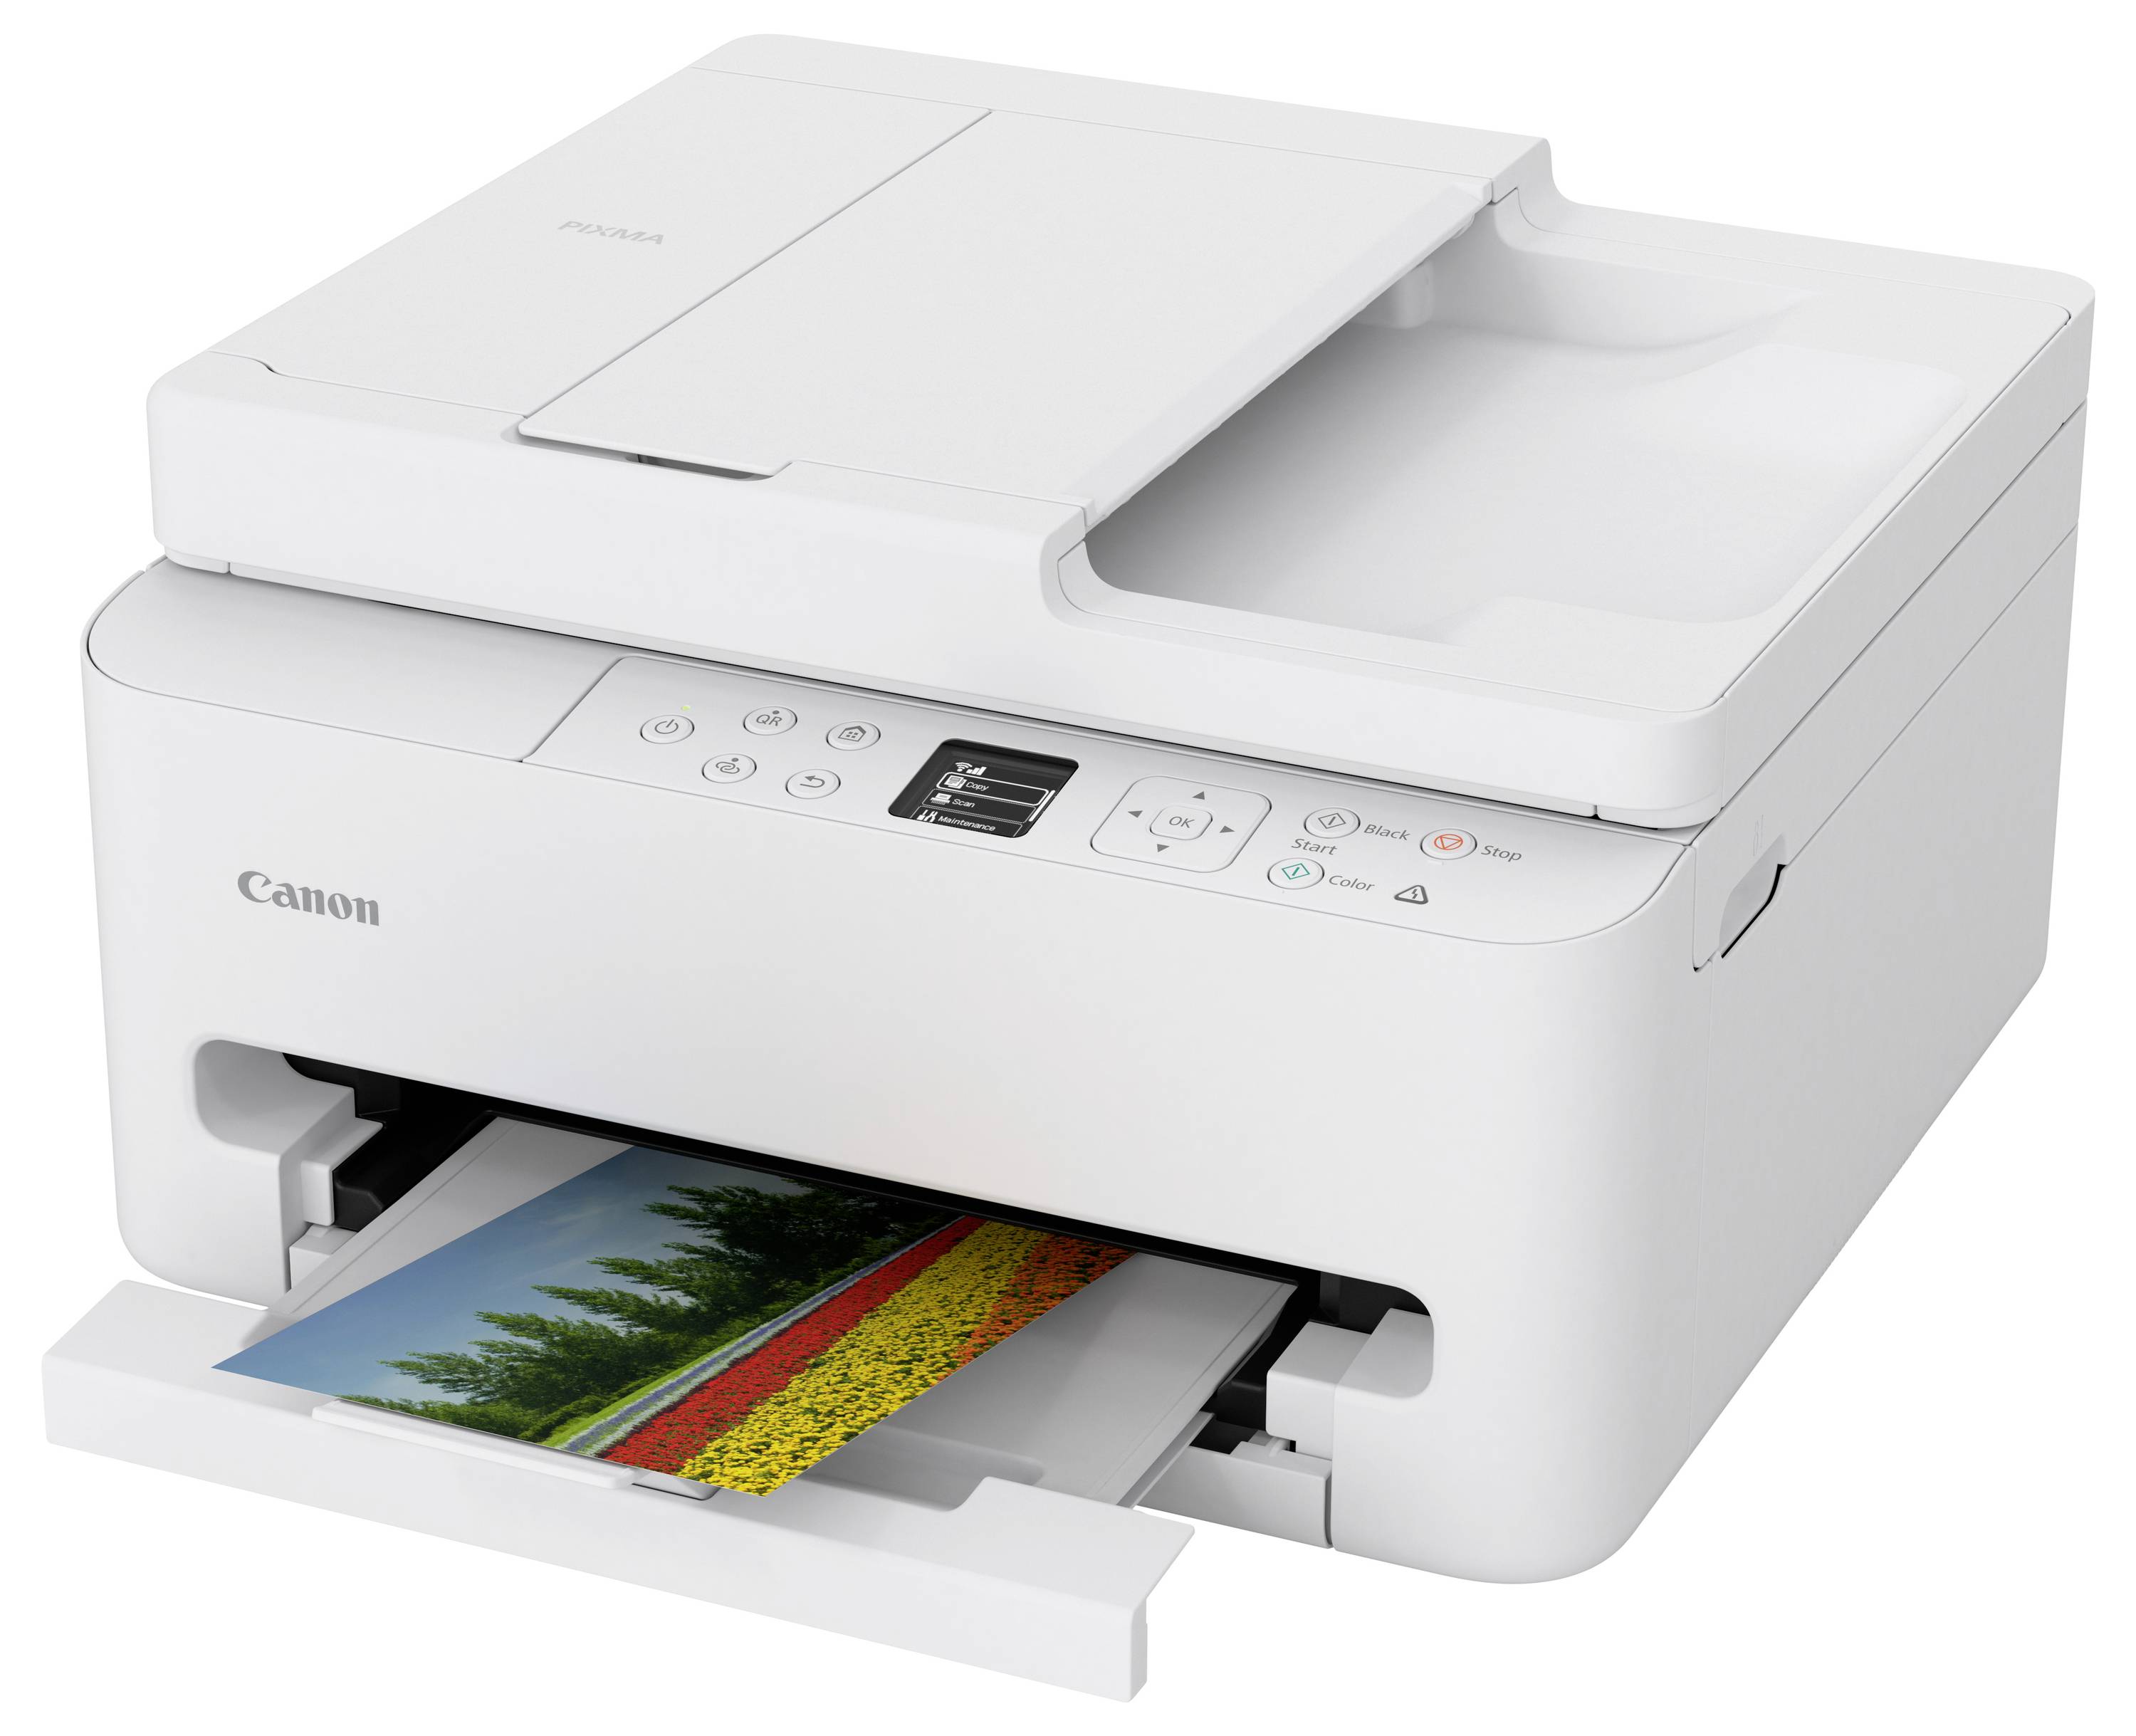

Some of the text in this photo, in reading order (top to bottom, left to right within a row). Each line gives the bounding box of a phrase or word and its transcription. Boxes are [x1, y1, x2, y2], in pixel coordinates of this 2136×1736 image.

[557, 221, 664, 245] PIXMA
[756, 714, 782, 726] QR
[965, 781, 990, 792] Copy
[951, 798, 975, 808] Scan
[938, 815, 996, 831] Maintenance
[1168, 816, 1195, 829] OK
[1363, 824, 1410, 841] Black
[1291, 838, 1337, 855] Start
[1480, 845, 1522, 862] Stop
[1329, 875, 1375, 891] Color
[237, 870, 379, 926] Canon
